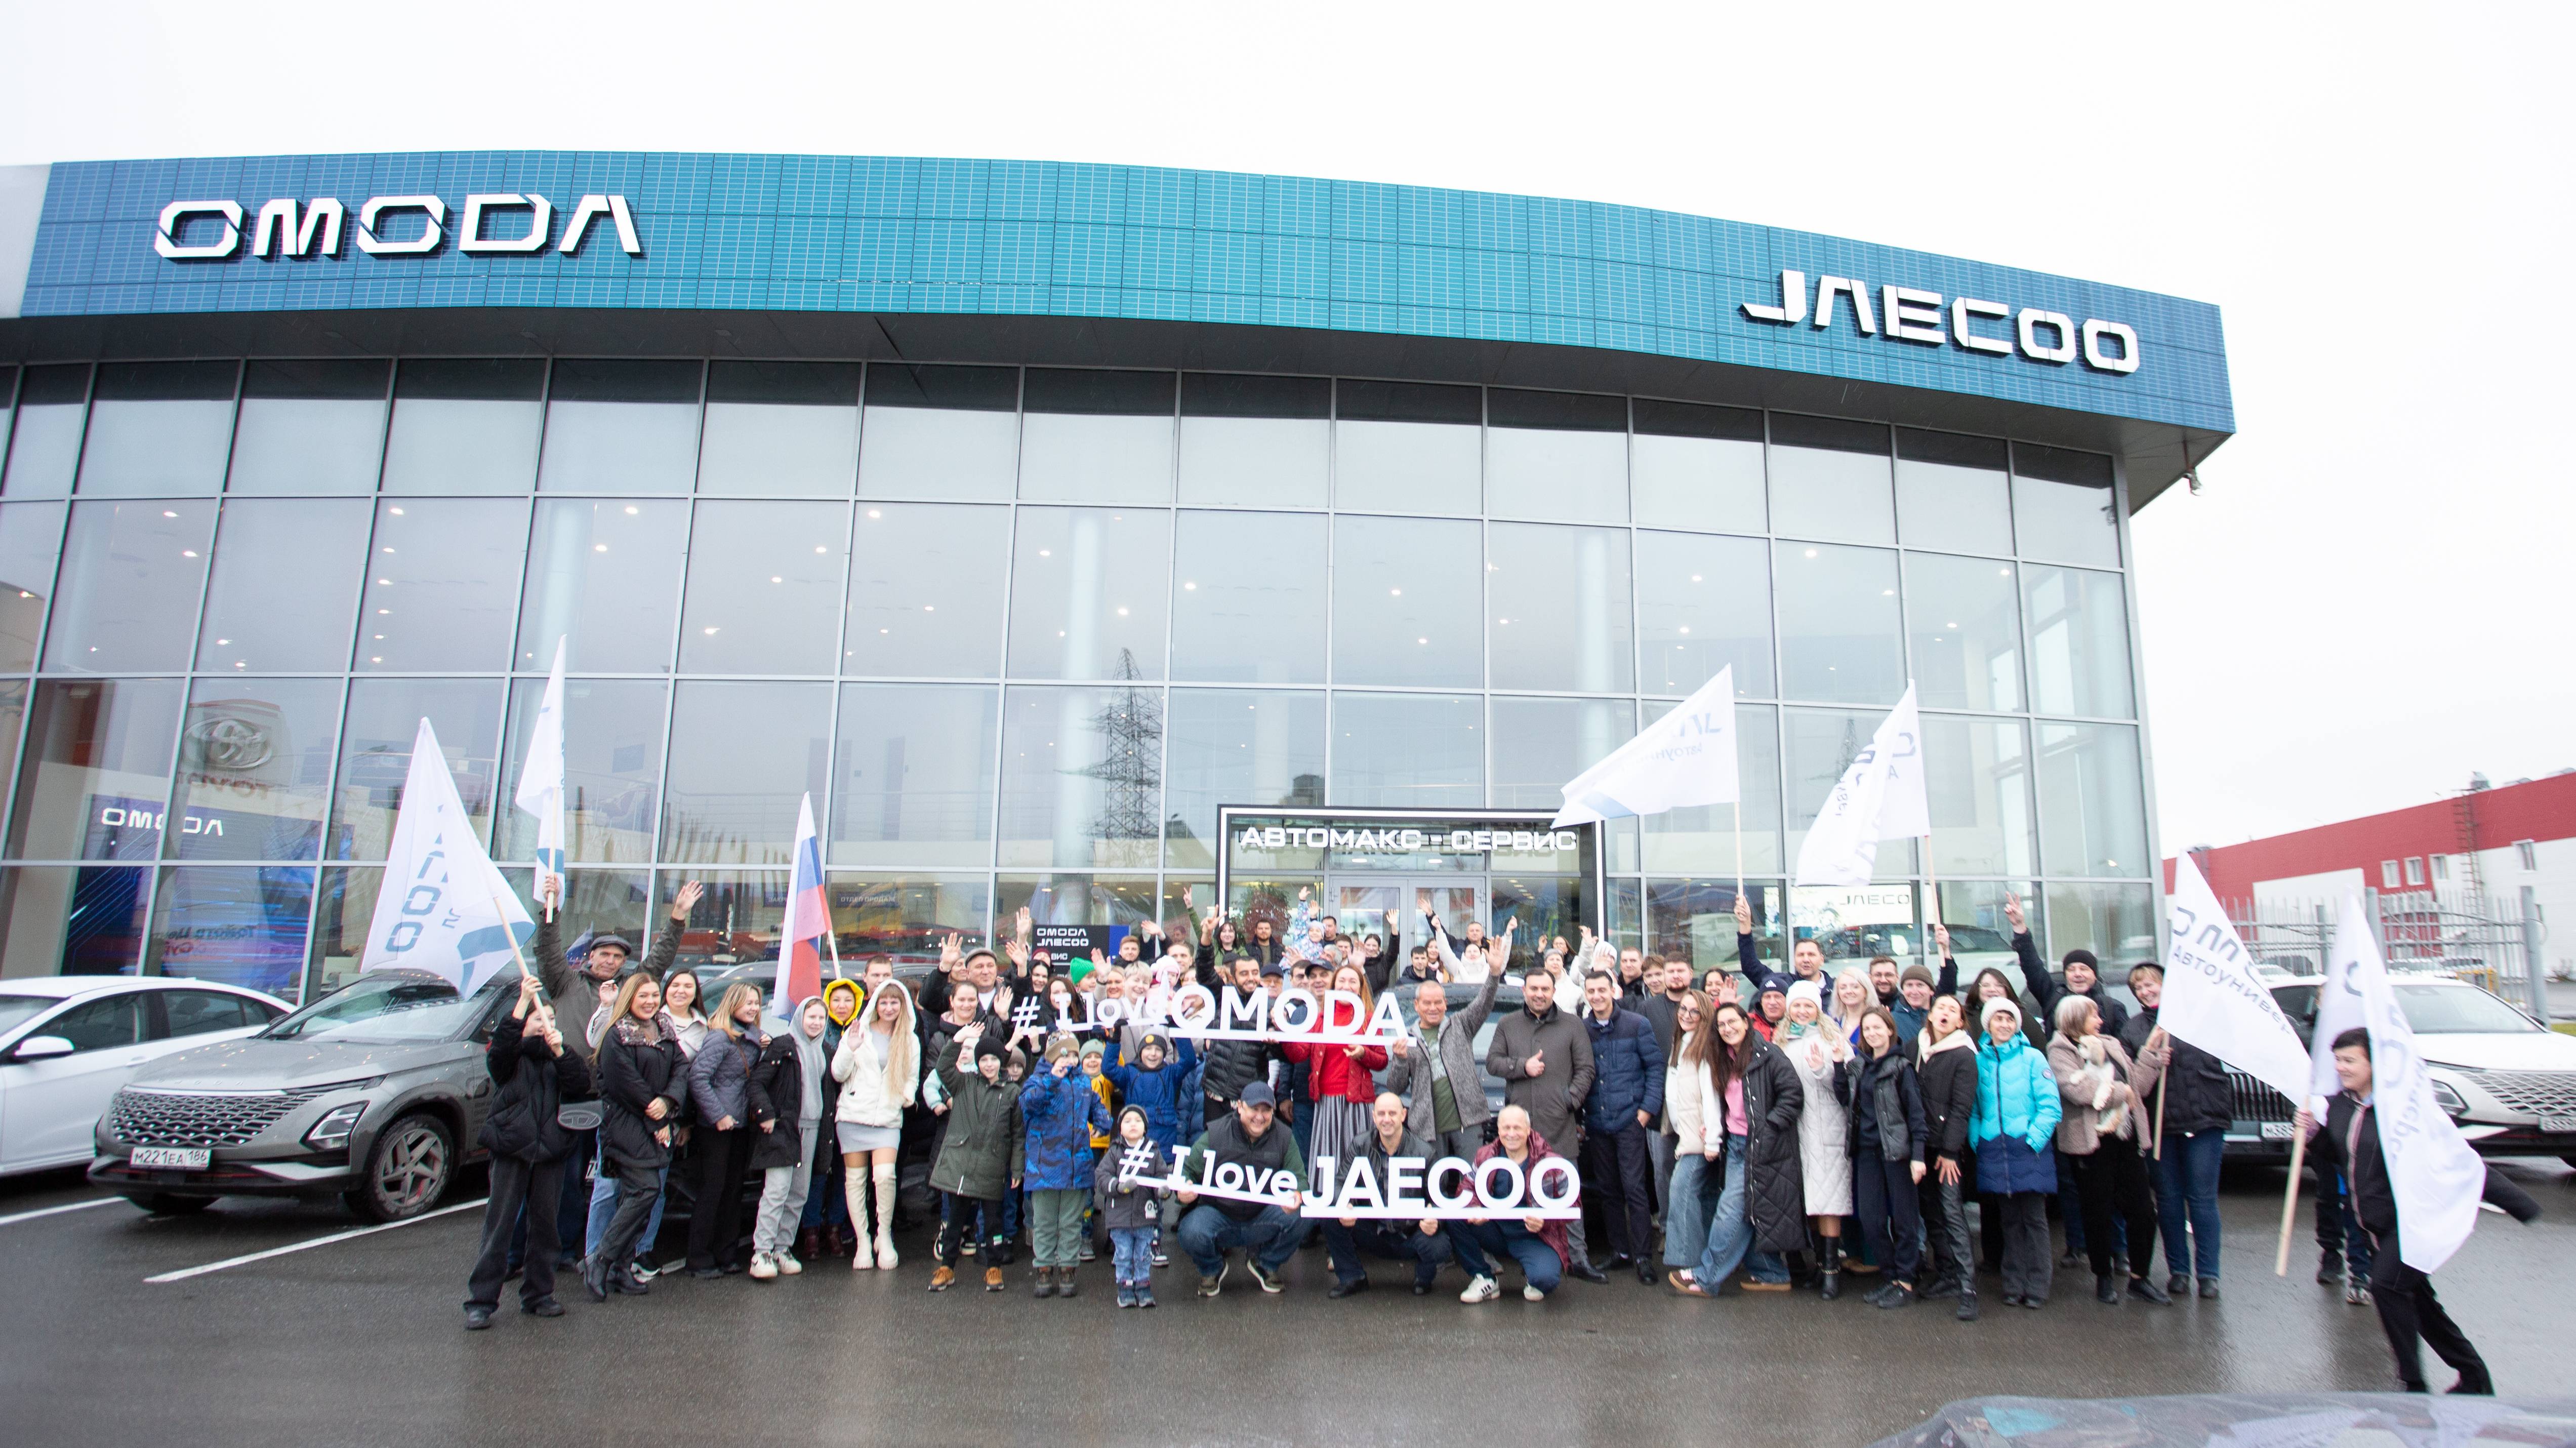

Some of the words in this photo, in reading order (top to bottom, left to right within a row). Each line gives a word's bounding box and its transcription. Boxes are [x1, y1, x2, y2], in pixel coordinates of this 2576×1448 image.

[154, 193, 642, 257] OMODA
[1743, 269, 2140, 373] JAECOO
[1240, 827, 1422, 850] АВТОМАКС
[1451, 830, 1577, 851] СЕРВИС
[1839, 895, 1910, 905] JAECO
[1037, 928, 1087, 936] OMODA
[1037, 938, 1089, 947] JAECOO
[1171, 984, 1409, 1037] OMODA
[1203, 1149, 1298, 1198] love
[1302, 1156, 1581, 1210] JAECOO
